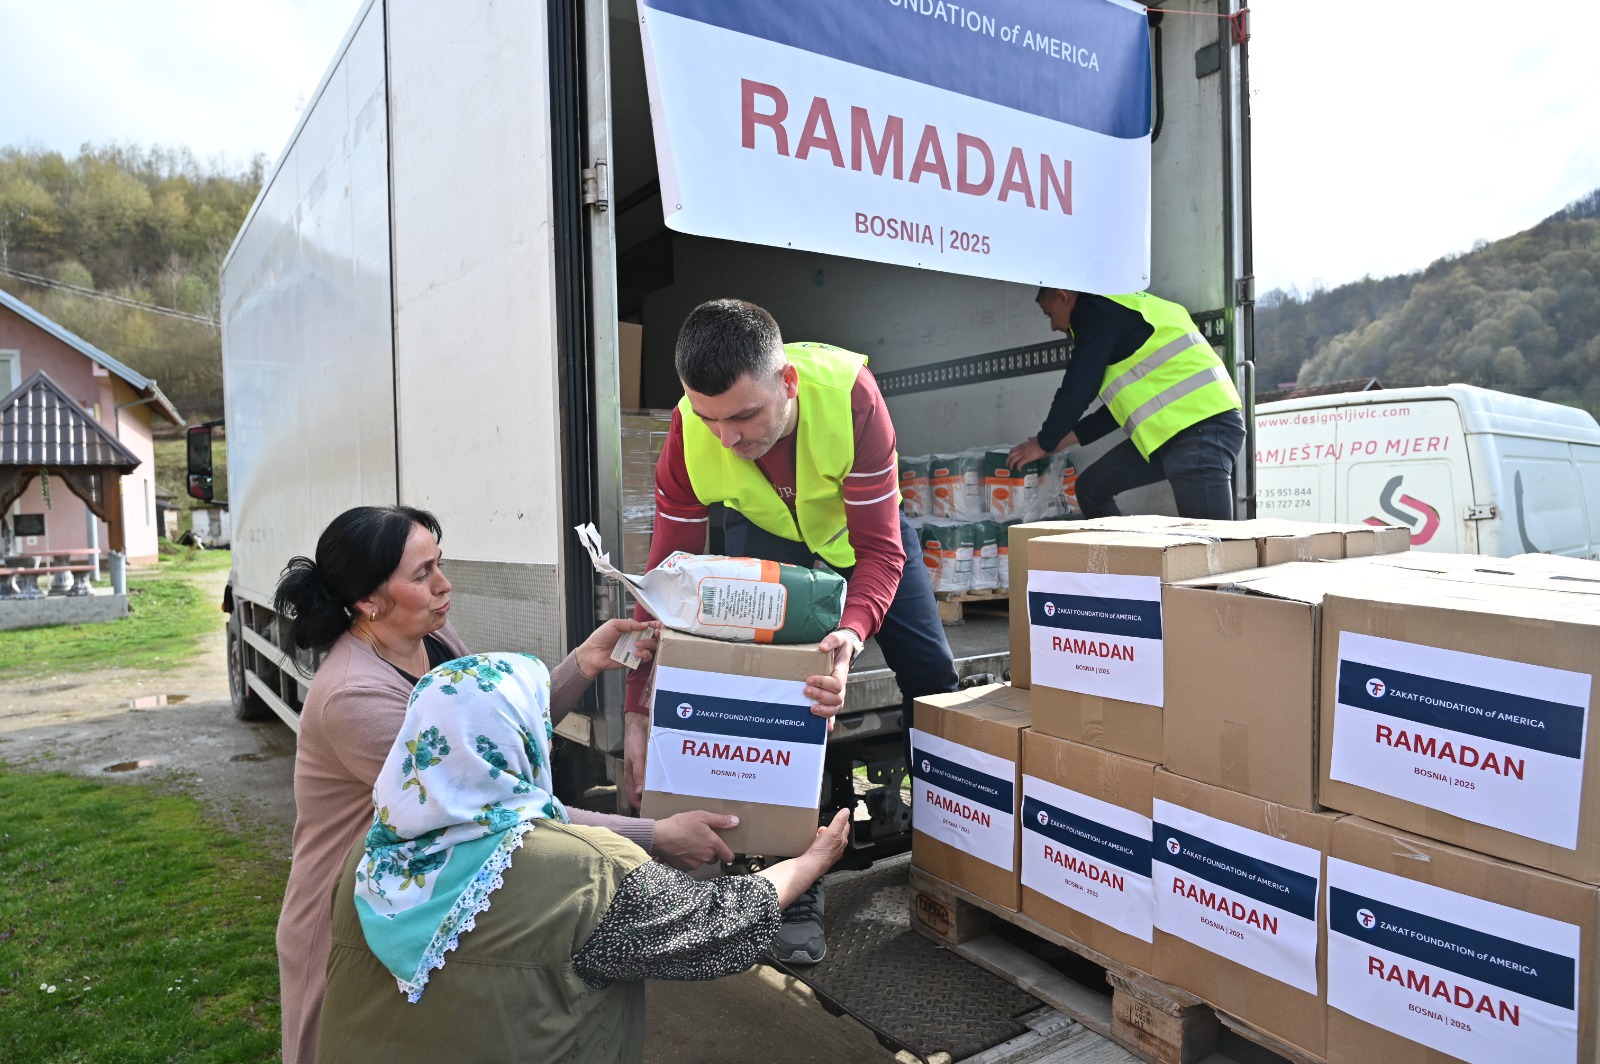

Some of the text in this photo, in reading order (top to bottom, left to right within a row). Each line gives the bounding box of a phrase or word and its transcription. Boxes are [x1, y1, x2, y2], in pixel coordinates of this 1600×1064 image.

[1000, 25, 1021, 44] of
[1023, 30, 1099, 72] AMERICA
[740, 77, 1073, 216] RAMADAN
[854, 211, 935, 247] BOSNIA
[949, 228, 991, 256] 2025
[1258, 406, 1410, 428] www.designsljivic.com
[1350, 440, 1378, 456] PO
[1385, 436, 1449, 456] MJERI
[1265, 489, 1275, 497] 35
[1277, 488, 1292, 497] 951
[1294, 488, 1312, 496] 844
[1266, 500, 1275, 509] 61
[1277, 500, 1292, 508] 727
[1295, 499, 1310, 508] 274
[1073, 609, 1109, 619] FOUNDATION
[1052, 636, 1134, 661] RAMADAN
[1075, 664, 1095, 672] BOSNIA
[696, 710, 719, 718] ZAKAT
[720, 713, 765, 723] FOUNDATION
[774, 718, 805, 727] AMERICA
[1389, 689, 1545, 729] ZAKAT FOUNDATION of AMERICA
[682, 739, 791, 766] RAMADAN
[1375, 723, 1525, 781] RAMADAN
[711, 769, 737, 777] BOSNIA
[1414, 766, 1448, 783] BOSNIA
[1454, 778, 1475, 790] 2025
[978, 785, 998, 796] AMERICA
[926, 790, 990, 828] RAMADAN
[1050, 819, 1066, 829] ZAKAT
[1066, 825, 1101, 844] FOUNDATION
[1108, 842, 1134, 855] AMERICA
[1044, 845, 1124, 892] RAMADAN
[1182, 848, 1202, 860] ZAKAT
[1202, 856, 1247, 878] FOUNDATION
[1257, 876, 1290, 894] AMERICA
[1064, 879, 1084, 891] BOSNIA
[1087, 888, 1098, 897] 2025
[1172, 877, 1278, 935] RAMADAN
[1200, 917, 1225, 932] BOSNIA
[1230, 929, 1244, 939] 2025
[1380, 921, 1538, 977] ZAKAT FOUNDATION of AMERICA
[1368, 955, 1519, 1026] RAMADAN
[1408, 1003, 1443, 1022] BOSNIA
[1450, 1018, 1472, 1032] 2025
